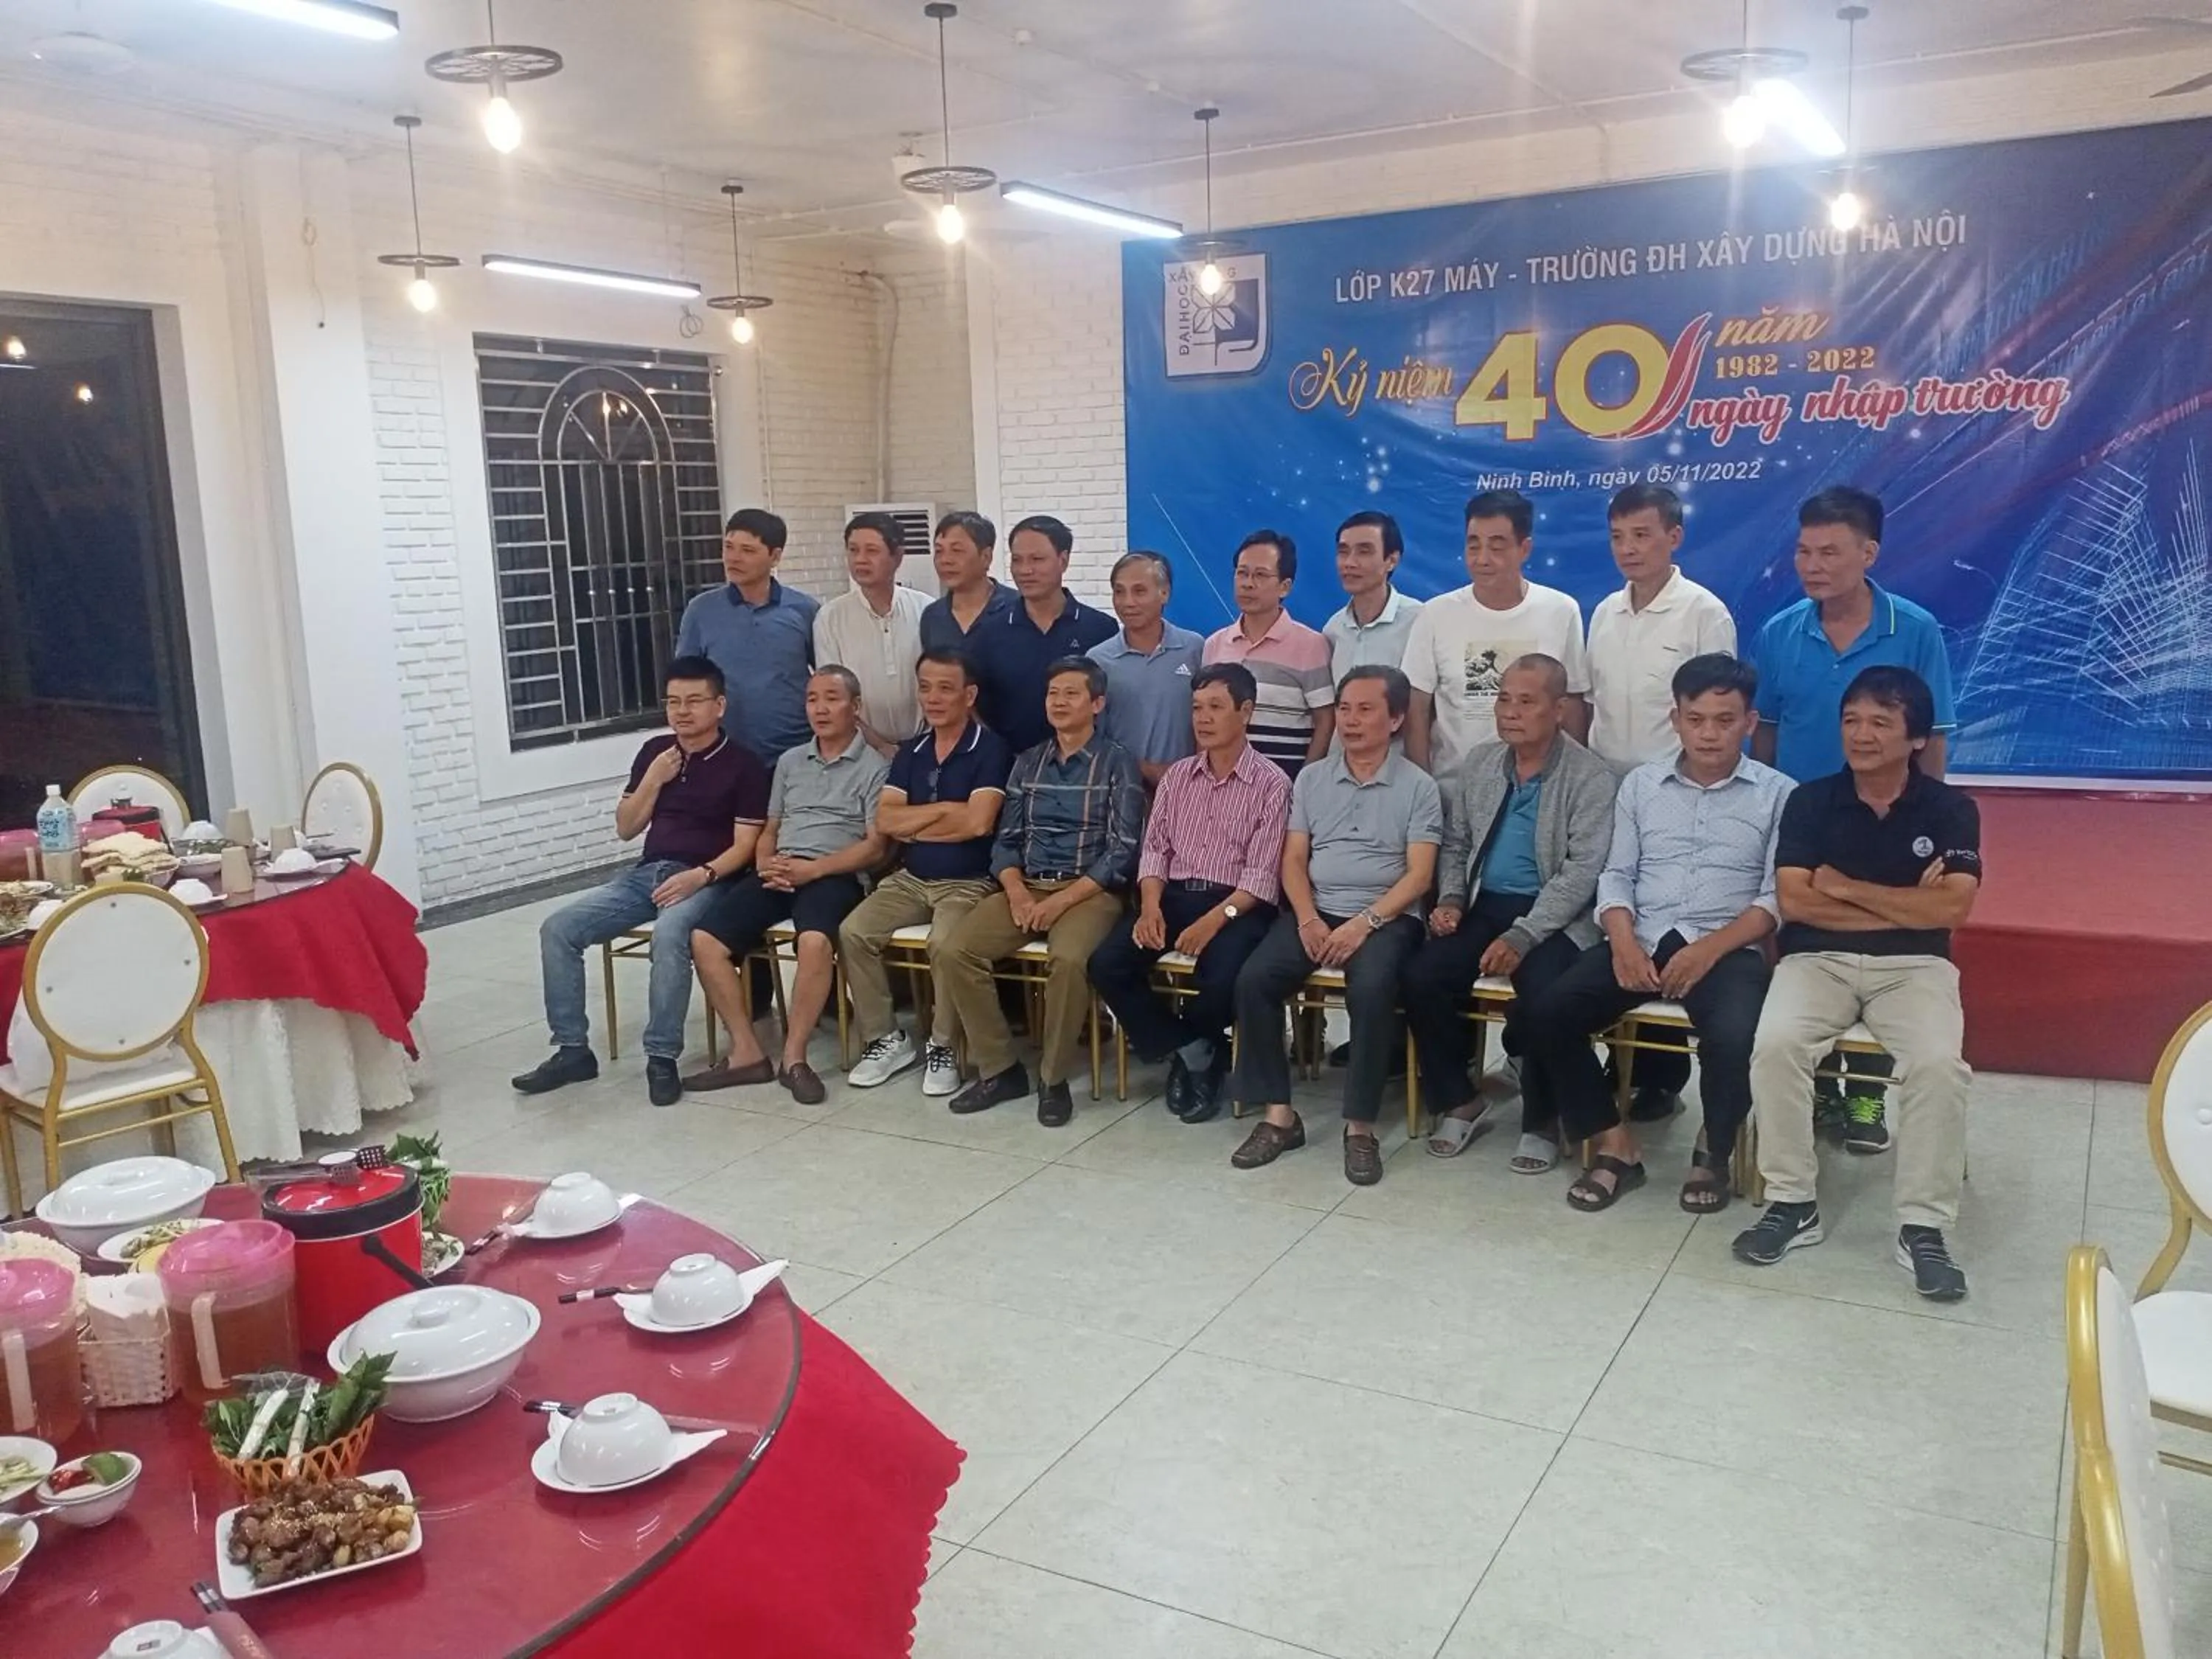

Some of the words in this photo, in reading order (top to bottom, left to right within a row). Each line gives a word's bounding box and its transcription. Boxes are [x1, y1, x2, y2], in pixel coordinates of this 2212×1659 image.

[1335, 269, 1382, 303] LỚP
[1390, 269, 1436, 297] K27
[1444, 257, 1499, 293] MÁY
[1526, 244, 1637, 285] TRƯỜNG
[1646, 242, 1686, 274] ĐH
[1697, 231, 1754, 268] XÂY
[1764, 226, 1847, 265] DỰNG
[1860, 214, 1902, 252] HÀ
[1913, 209, 1966, 252] NỘI
[1374, 355, 1454, 405] niệm
[1455, 322, 1669, 441] 40
[1715, 307, 1830, 348] năm
[1716, 353, 1778, 379] 1982
[1807, 346, 1875, 373] 2022
[1686, 386, 1793, 447] ngày
[1801, 375, 1908, 431] nhập
[1913, 369, 2071, 431] trường
[1476, 472, 1523, 490] Ninh
[1646, 461, 1762, 484] 05/11/2022
